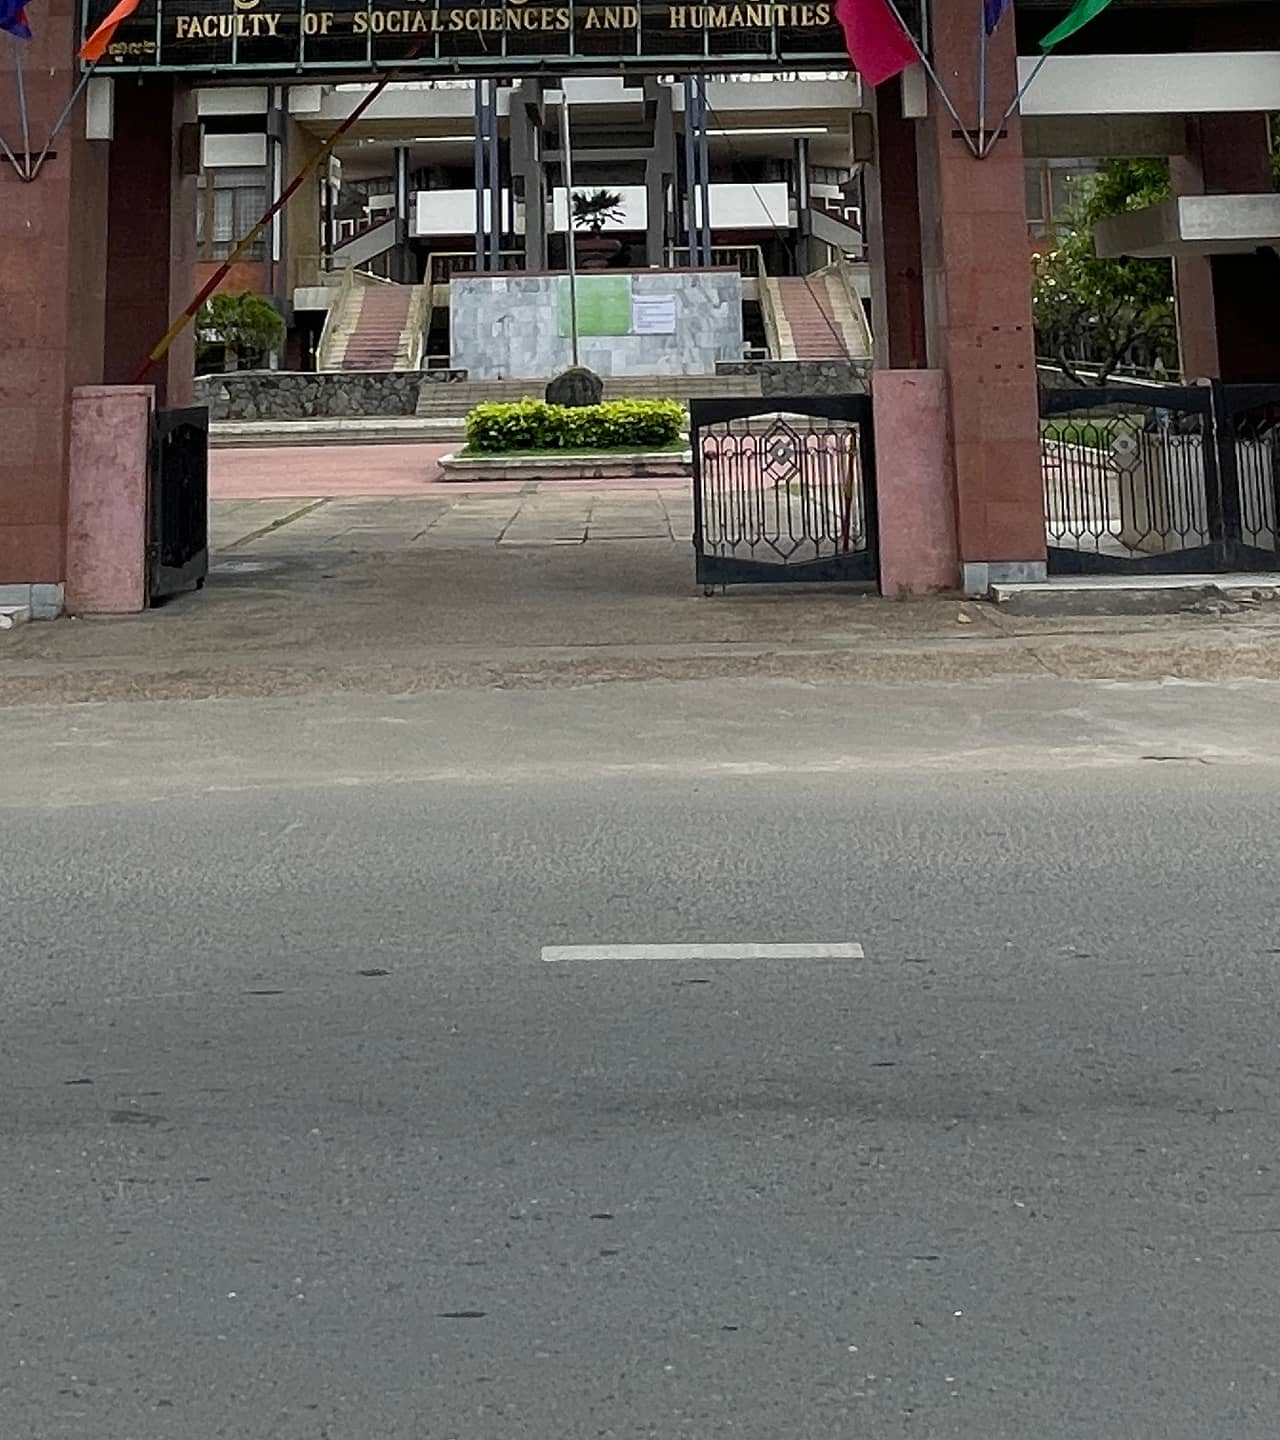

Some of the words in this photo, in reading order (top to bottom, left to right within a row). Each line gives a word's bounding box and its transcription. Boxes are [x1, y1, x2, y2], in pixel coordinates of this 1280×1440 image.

[176, 14, 282, 38] FACULTY
[304, 12, 334, 36] OF
[353, 9, 444, 34] SOCIAL
[448, 7, 571, 32] SCIENCES
[585, 7, 637, 30] AND
[670, 4, 831, 29] HUMANITIES
